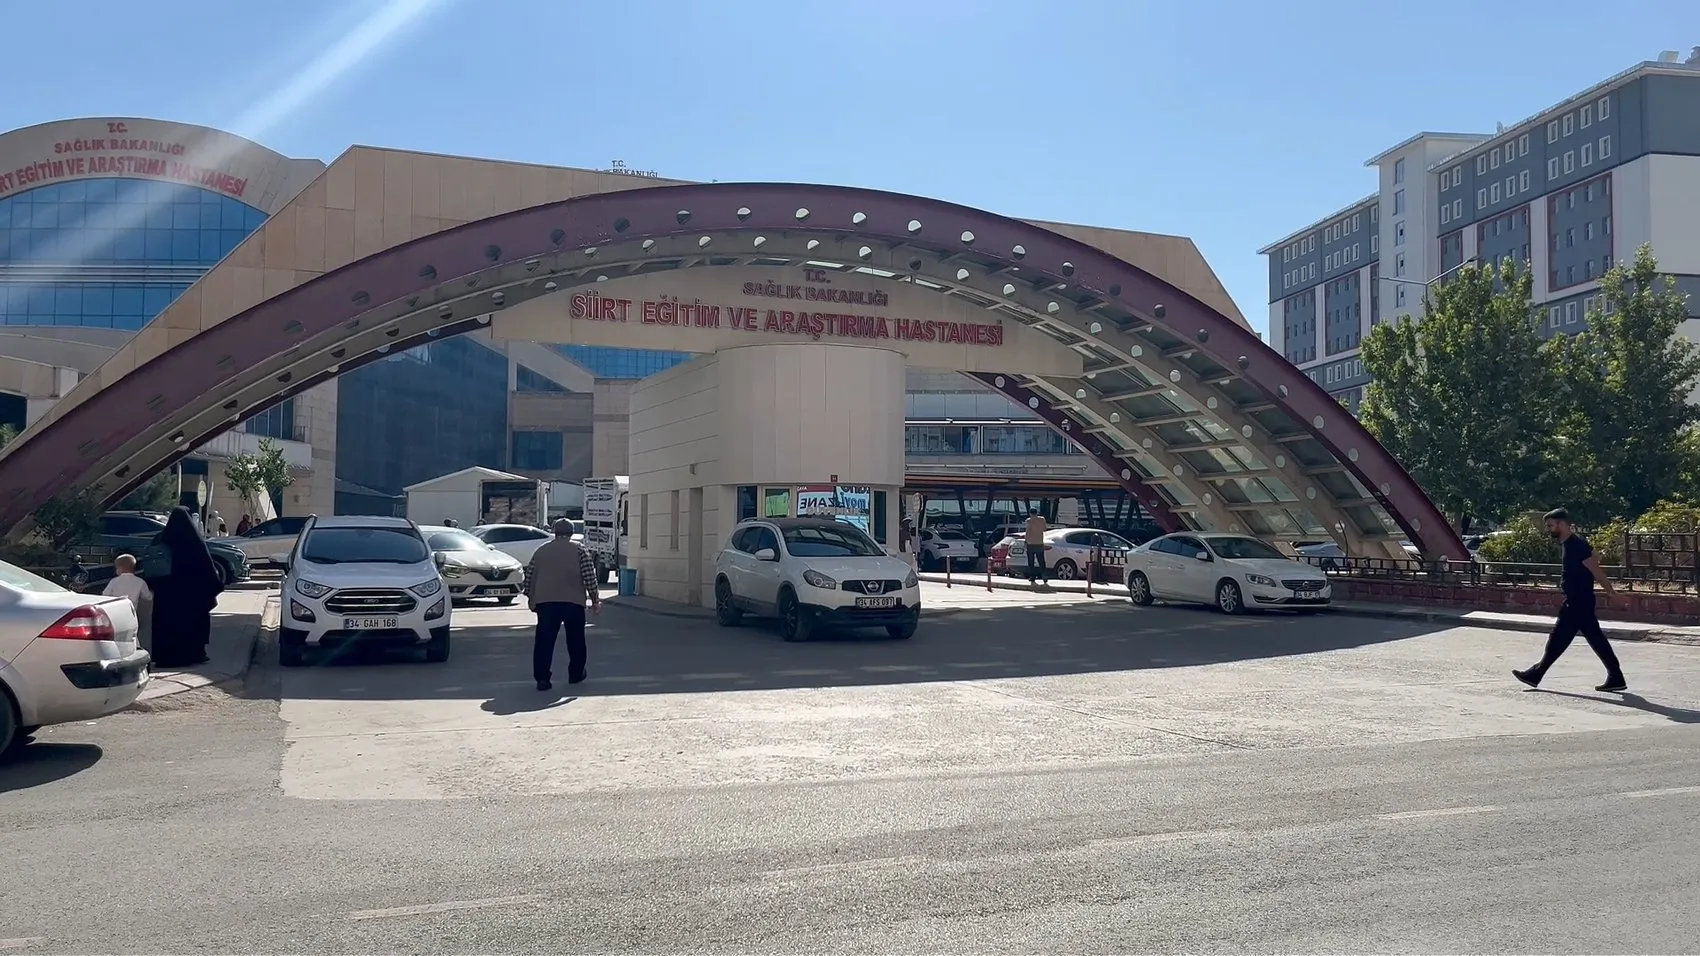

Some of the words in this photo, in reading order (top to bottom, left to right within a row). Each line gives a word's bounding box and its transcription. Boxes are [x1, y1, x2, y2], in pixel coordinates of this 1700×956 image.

[54, 137, 105, 154] SAĞLIK
[66, 158, 85, 175] VE
[611, 159, 627, 168] T.C.
[803, 268, 831, 284] T.C.
[742, 279, 802, 300] SAĞLIK
[805, 286, 888, 306] BAKANLIĞI
[570, 288, 632, 323] SİİRT
[640, 293, 721, 329] EĞİTİM
[727, 305, 759, 332] VE
[764, 308, 890, 341] ARAŞTIRMA
[895, 318, 1004, 346] HASTANESİ
[350, 619, 359, 628] 34
[363, 619, 379, 628] GAH
[383, 618, 397, 628] 168
